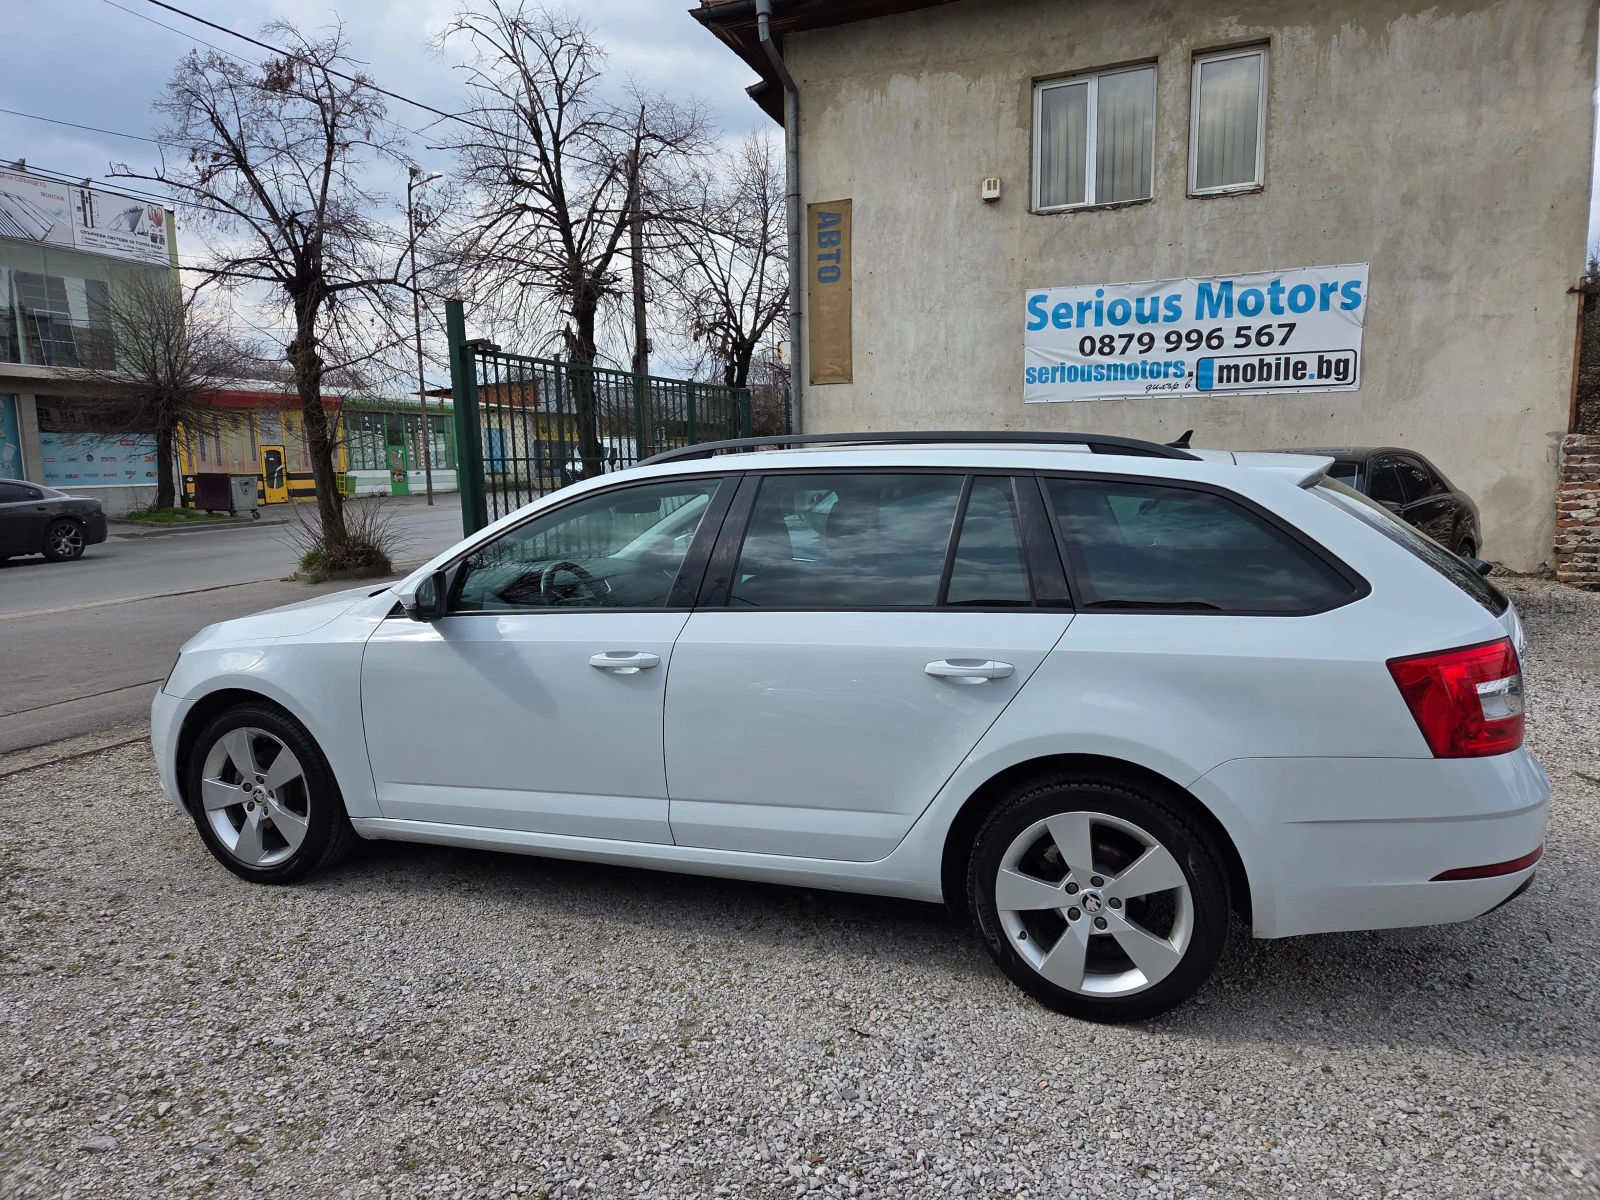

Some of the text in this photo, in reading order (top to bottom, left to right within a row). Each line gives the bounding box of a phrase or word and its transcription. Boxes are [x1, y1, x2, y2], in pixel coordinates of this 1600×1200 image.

[15, 176, 47, 188] СЛЪНЦЕТО
[41, 191, 65, 201] МОНТАЖ
[80, 229, 107, 239] СЛЪНЧЕВИ
[107, 235, 129, 243] СИСТЕМИ
[817, 211, 842, 284] АВТО
[1026, 278, 1363, 331] Serious Motors
[1078, 322, 1297, 357] 0879 996 567
[1217, 354, 1350, 386] mobile.bg
[144, 455, 155, 463] 3M
